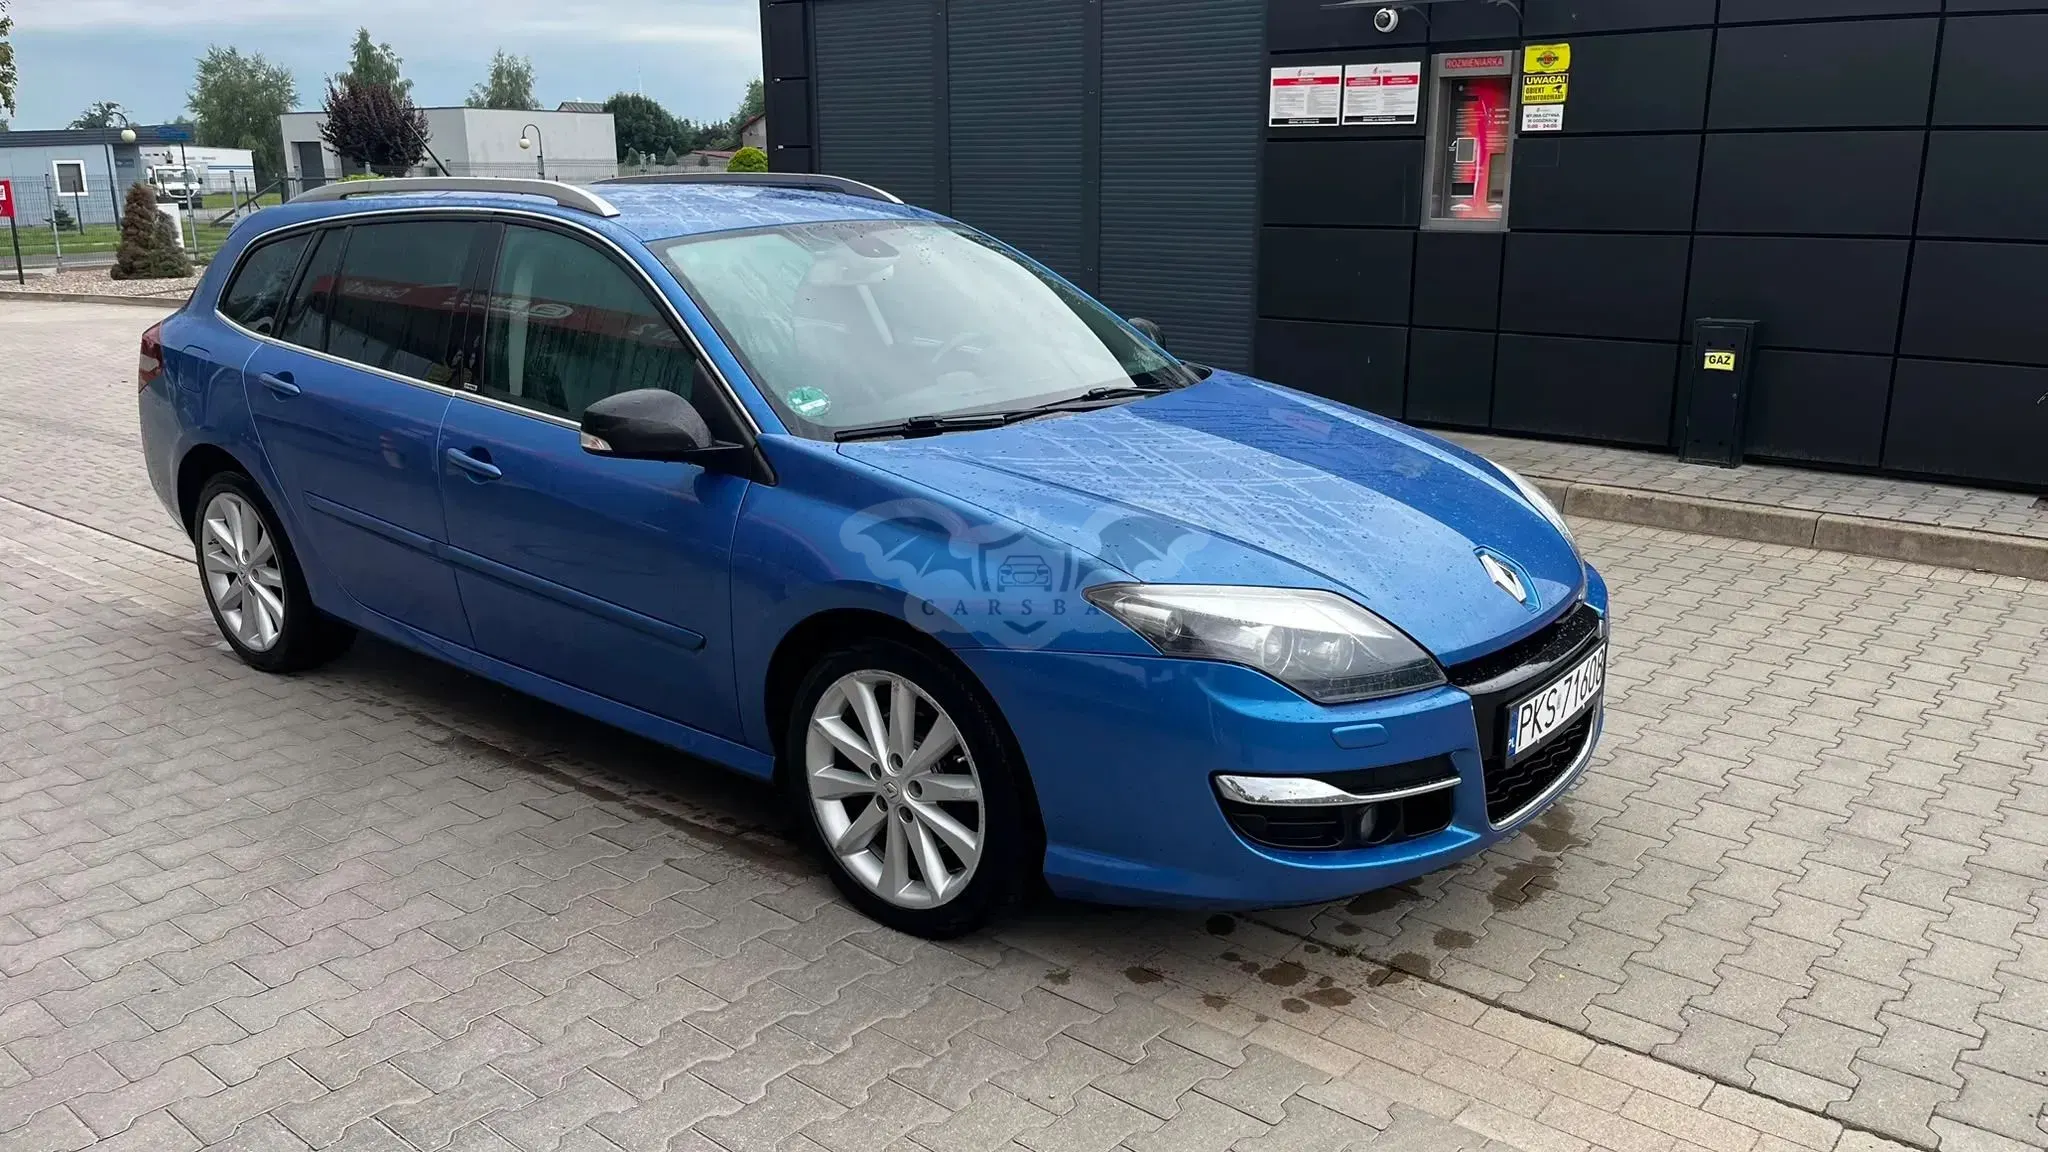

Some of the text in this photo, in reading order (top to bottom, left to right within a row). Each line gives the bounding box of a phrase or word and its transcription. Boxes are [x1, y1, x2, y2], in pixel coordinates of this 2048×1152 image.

[1446, 57, 1504, 68] ROZMIENIARKA
[1527, 76, 1565, 84] UWAGA!
[1709, 355, 1730, 365] GAZ
[1518, 648, 1604, 747] PKS 71608
[1508, 737, 1515, 748] PL
